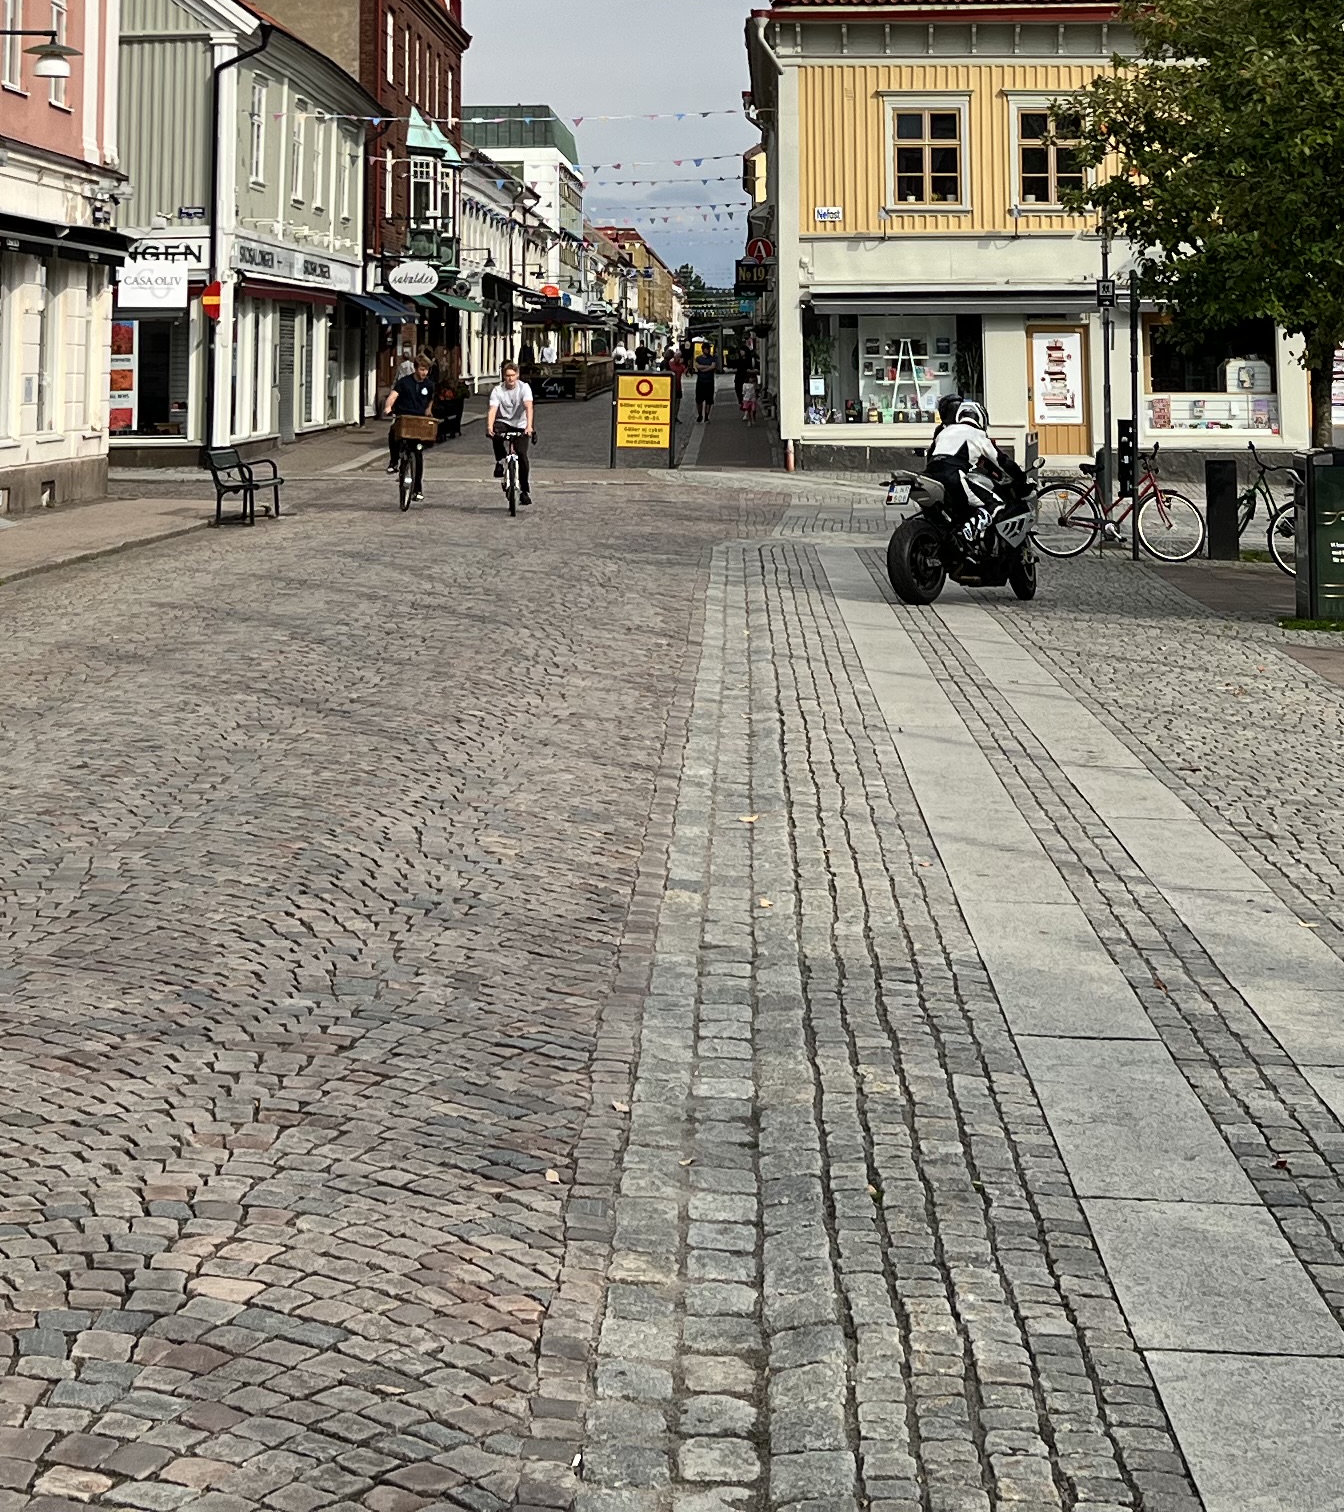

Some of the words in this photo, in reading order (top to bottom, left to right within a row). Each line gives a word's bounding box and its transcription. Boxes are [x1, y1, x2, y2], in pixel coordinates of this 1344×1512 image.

[753, 267, 765, 281] 19
[124, 276, 153, 285] CASA
[154, 276, 182, 285] OLIV
